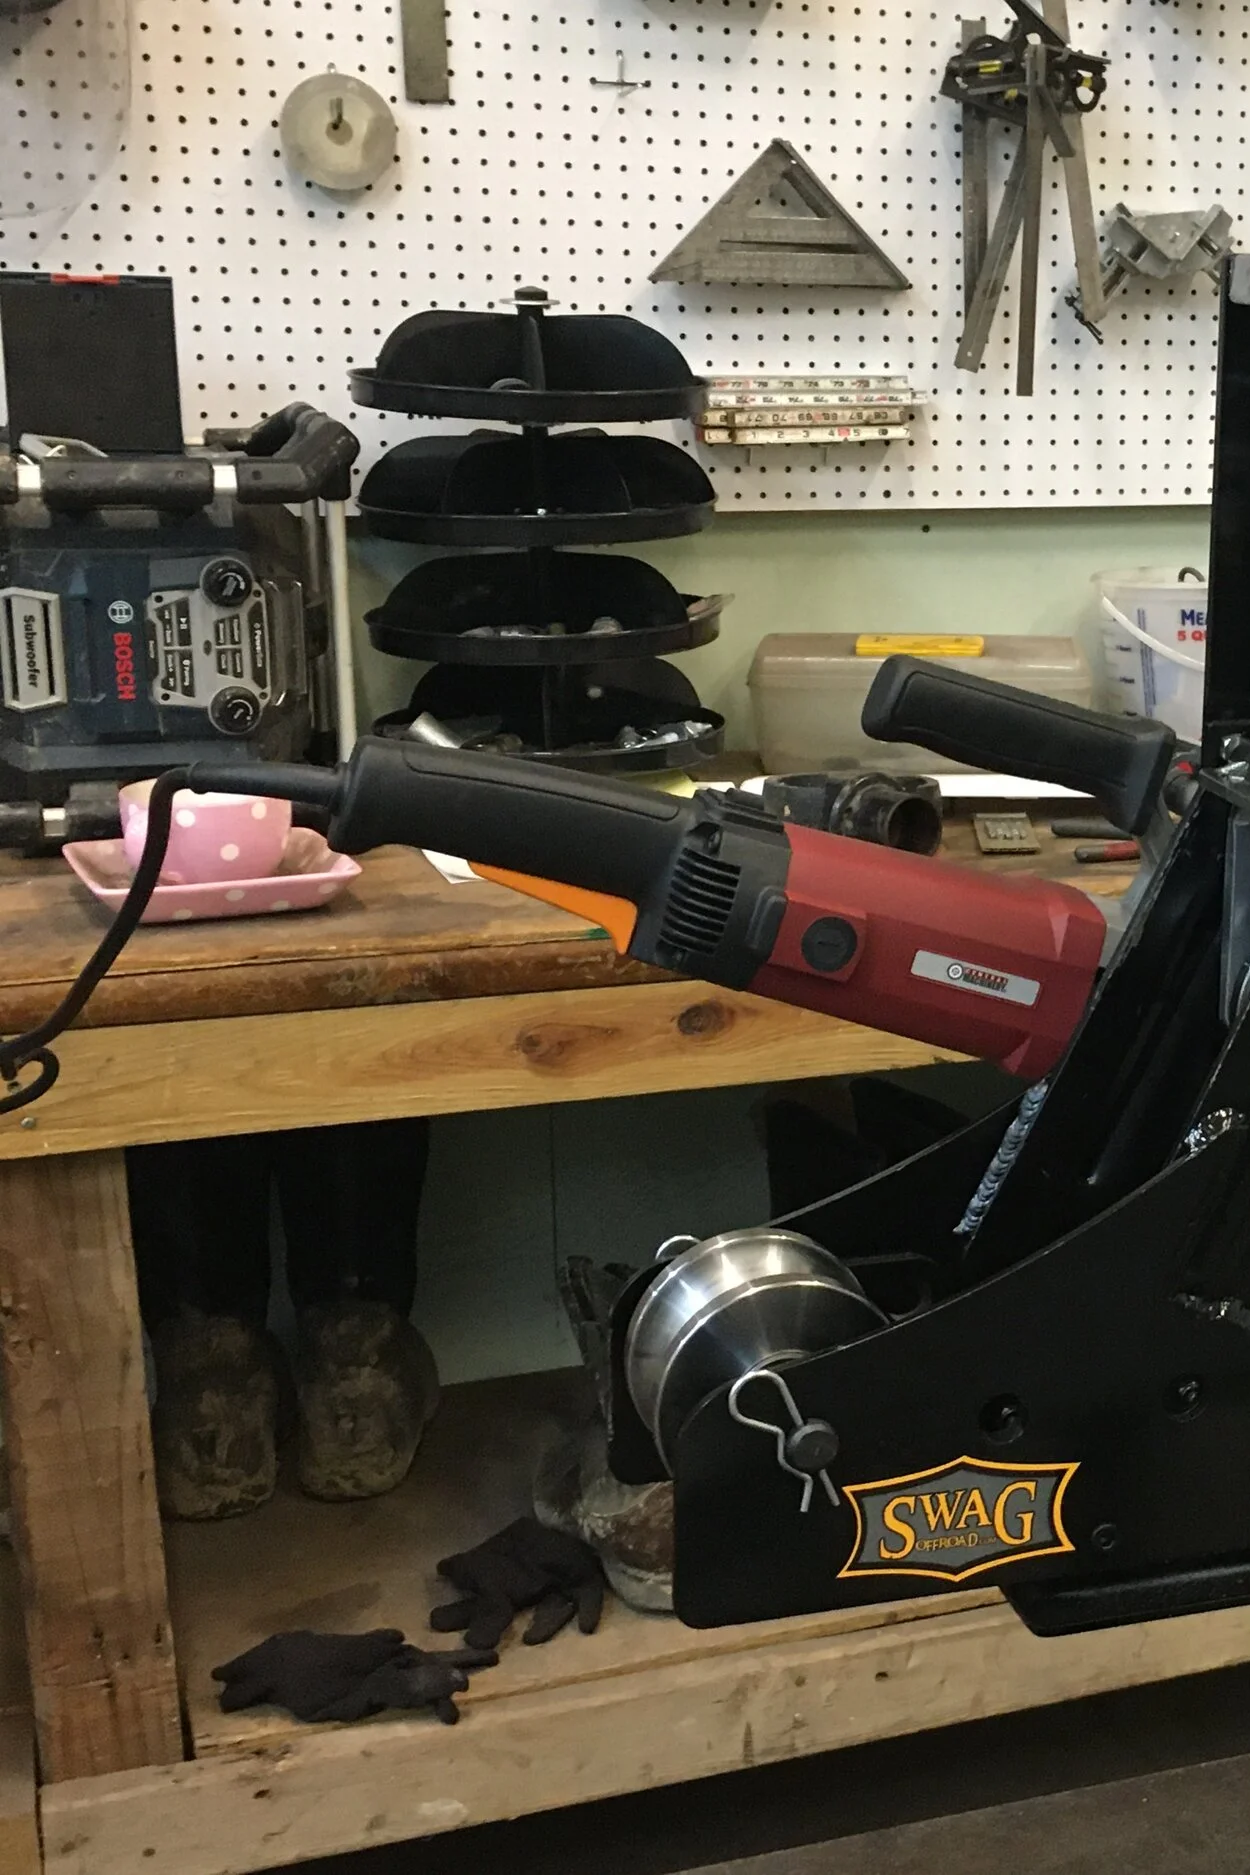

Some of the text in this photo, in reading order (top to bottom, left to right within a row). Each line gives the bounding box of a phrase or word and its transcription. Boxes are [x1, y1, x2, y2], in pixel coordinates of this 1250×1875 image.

[23, 614, 41, 689] Subwoofer
[112, 632, 137, 700] BOSCH
[1177, 630, 1187, 641] 5
[879, 1480, 1039, 1560] SWAG
